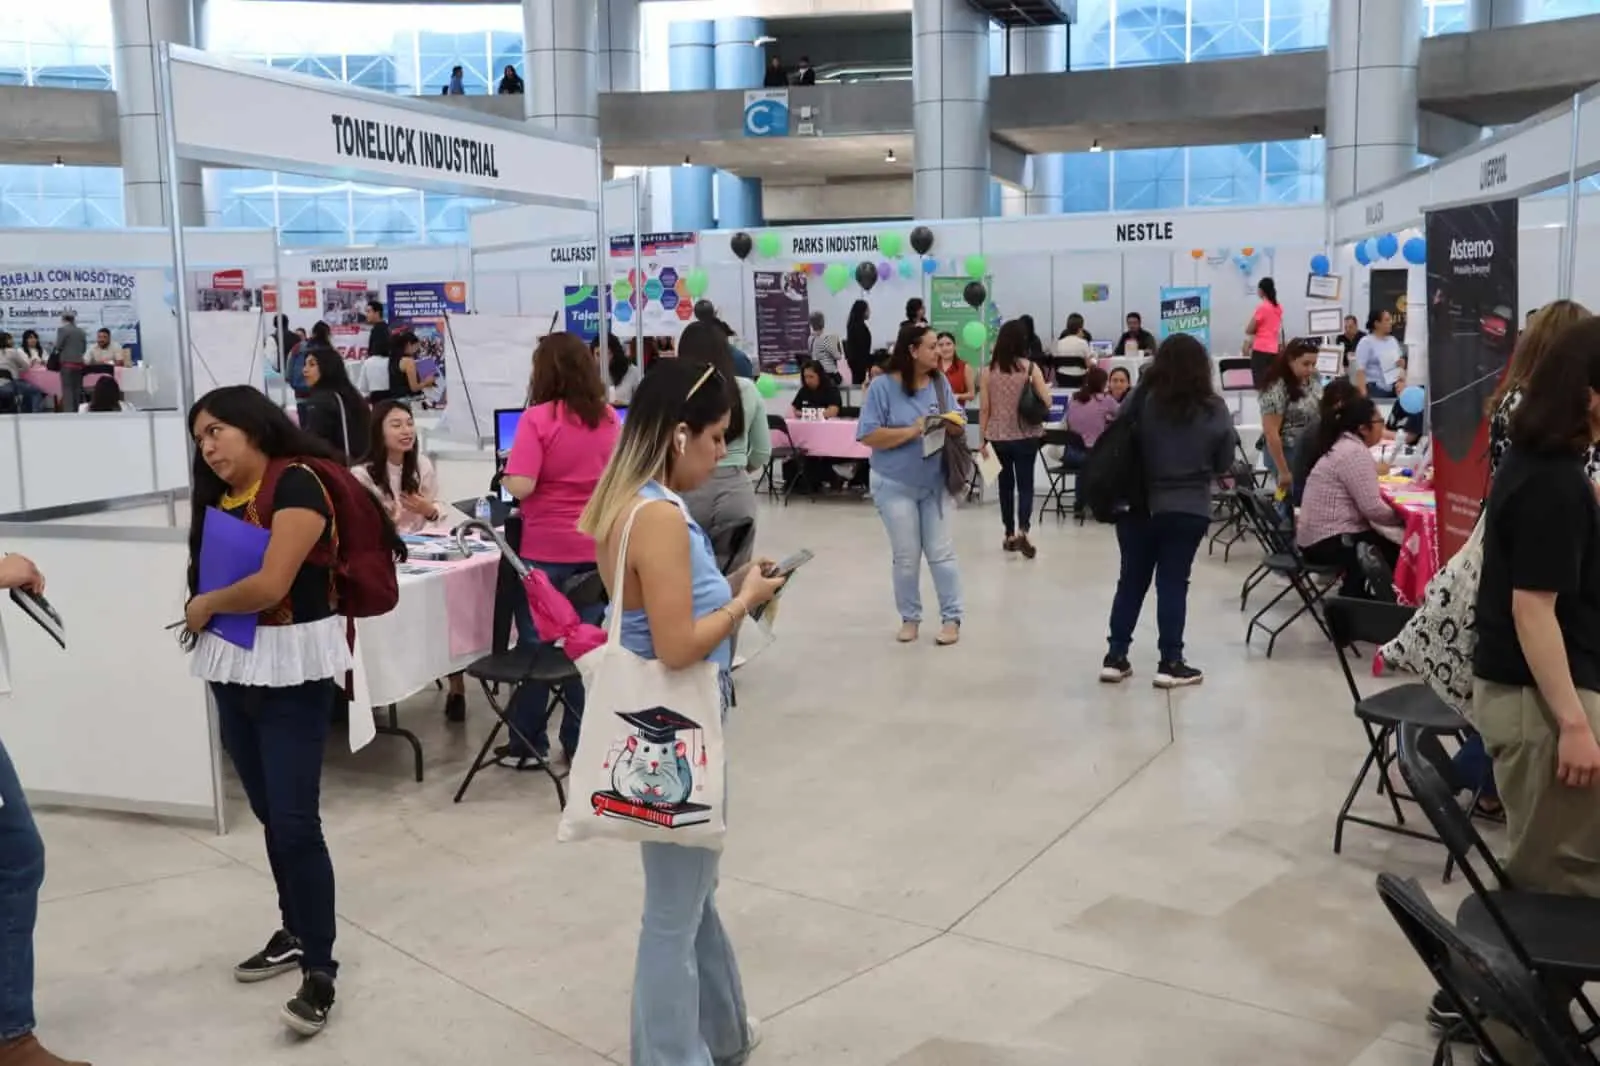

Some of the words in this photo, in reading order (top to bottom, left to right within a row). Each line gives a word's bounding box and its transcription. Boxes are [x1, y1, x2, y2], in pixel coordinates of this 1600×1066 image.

[747, 106, 769, 134] C
[332, 114, 417, 165] TONELUCK
[419, 130, 498, 178] INDUSTRIAL
[1117, 222, 1173, 242] NESTLE
[793, 237, 824, 253] PARKS
[1450, 239, 1494, 259] Astemo
[551, 247, 596, 262] CALLFASST
[349, 258, 359, 271] DE
[360, 256, 388, 271] MEXICO
[1, 271, 45, 286] RABAJA
[48, 270, 71, 282] CON
[74, 270, 135, 288] NOSOTROS
[0, 287, 48, 300] ESTAMOS
[53, 287, 131, 299] CONTRATANDO
[9, 306, 48, 317] Excelente
[1175, 300, 1186, 308] EL
[1179, 316, 1208, 329] VIDA
